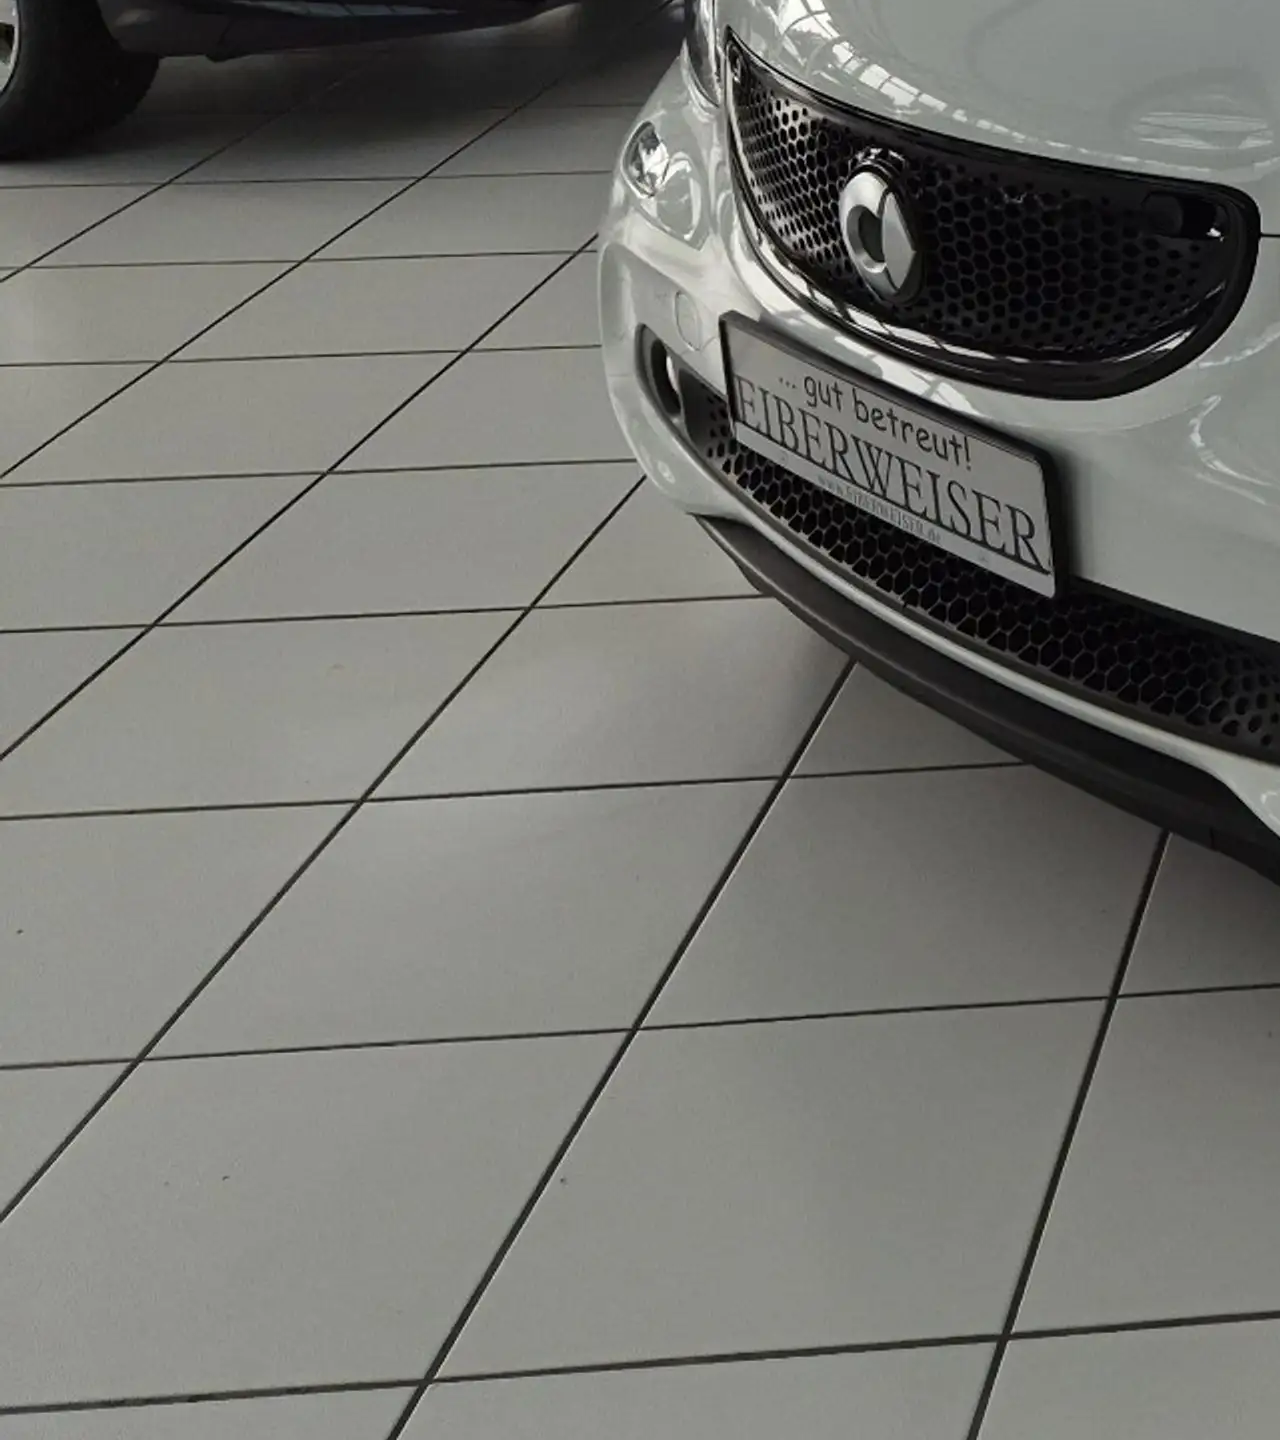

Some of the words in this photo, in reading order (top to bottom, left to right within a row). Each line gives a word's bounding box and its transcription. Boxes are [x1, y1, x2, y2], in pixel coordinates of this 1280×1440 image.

[734, 374, 1052, 575] EIBERWEISER
[803, 374, 843, 409] gut
[852, 387, 972, 471] betreut!
